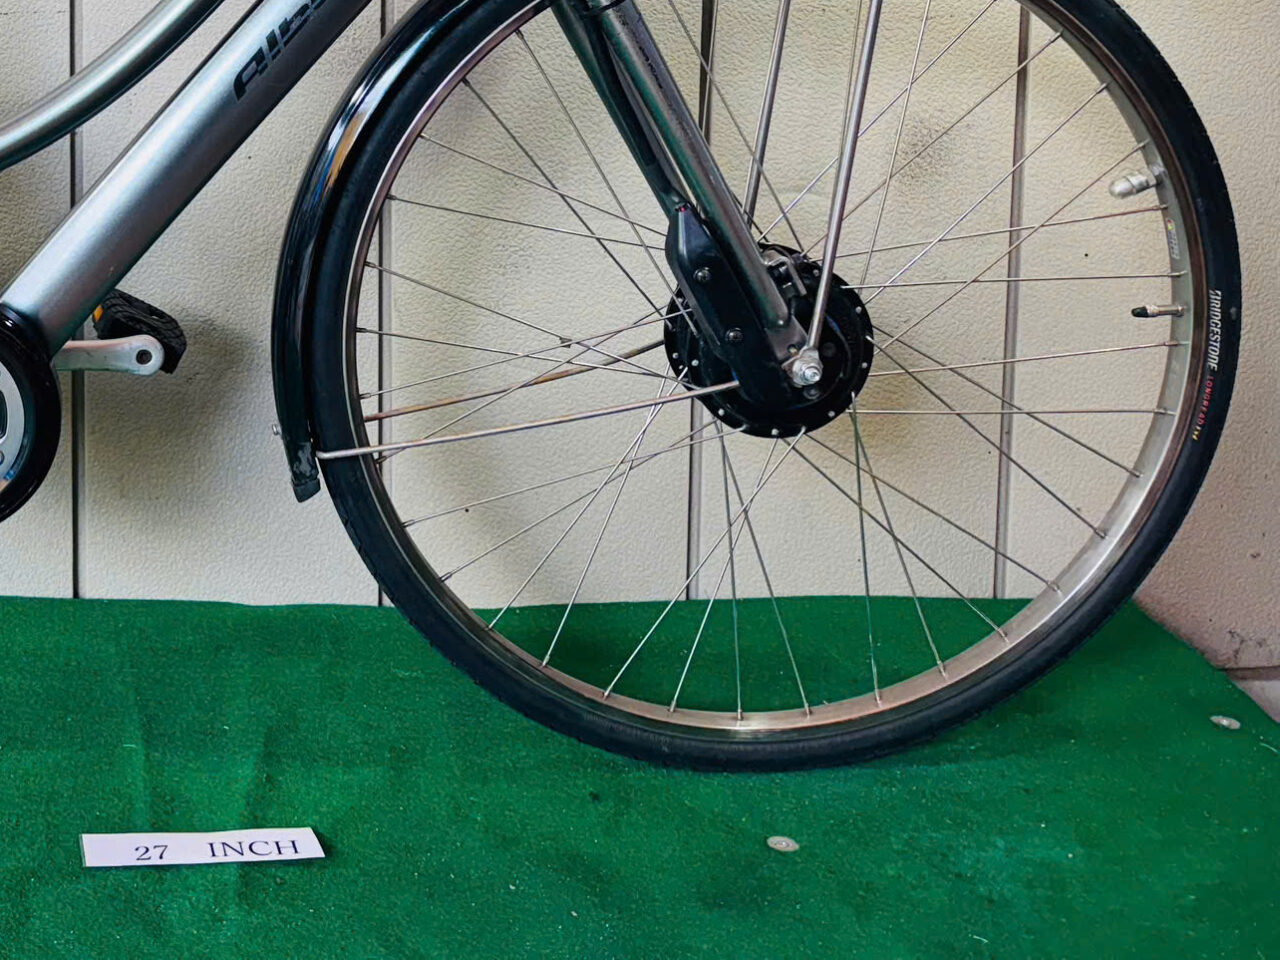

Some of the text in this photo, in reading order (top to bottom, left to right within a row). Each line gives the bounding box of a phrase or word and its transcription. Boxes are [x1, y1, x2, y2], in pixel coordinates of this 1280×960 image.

[1207, 290, 1222, 371] BRIDGESTONE
[133, 840, 300, 861] 27 INCH
